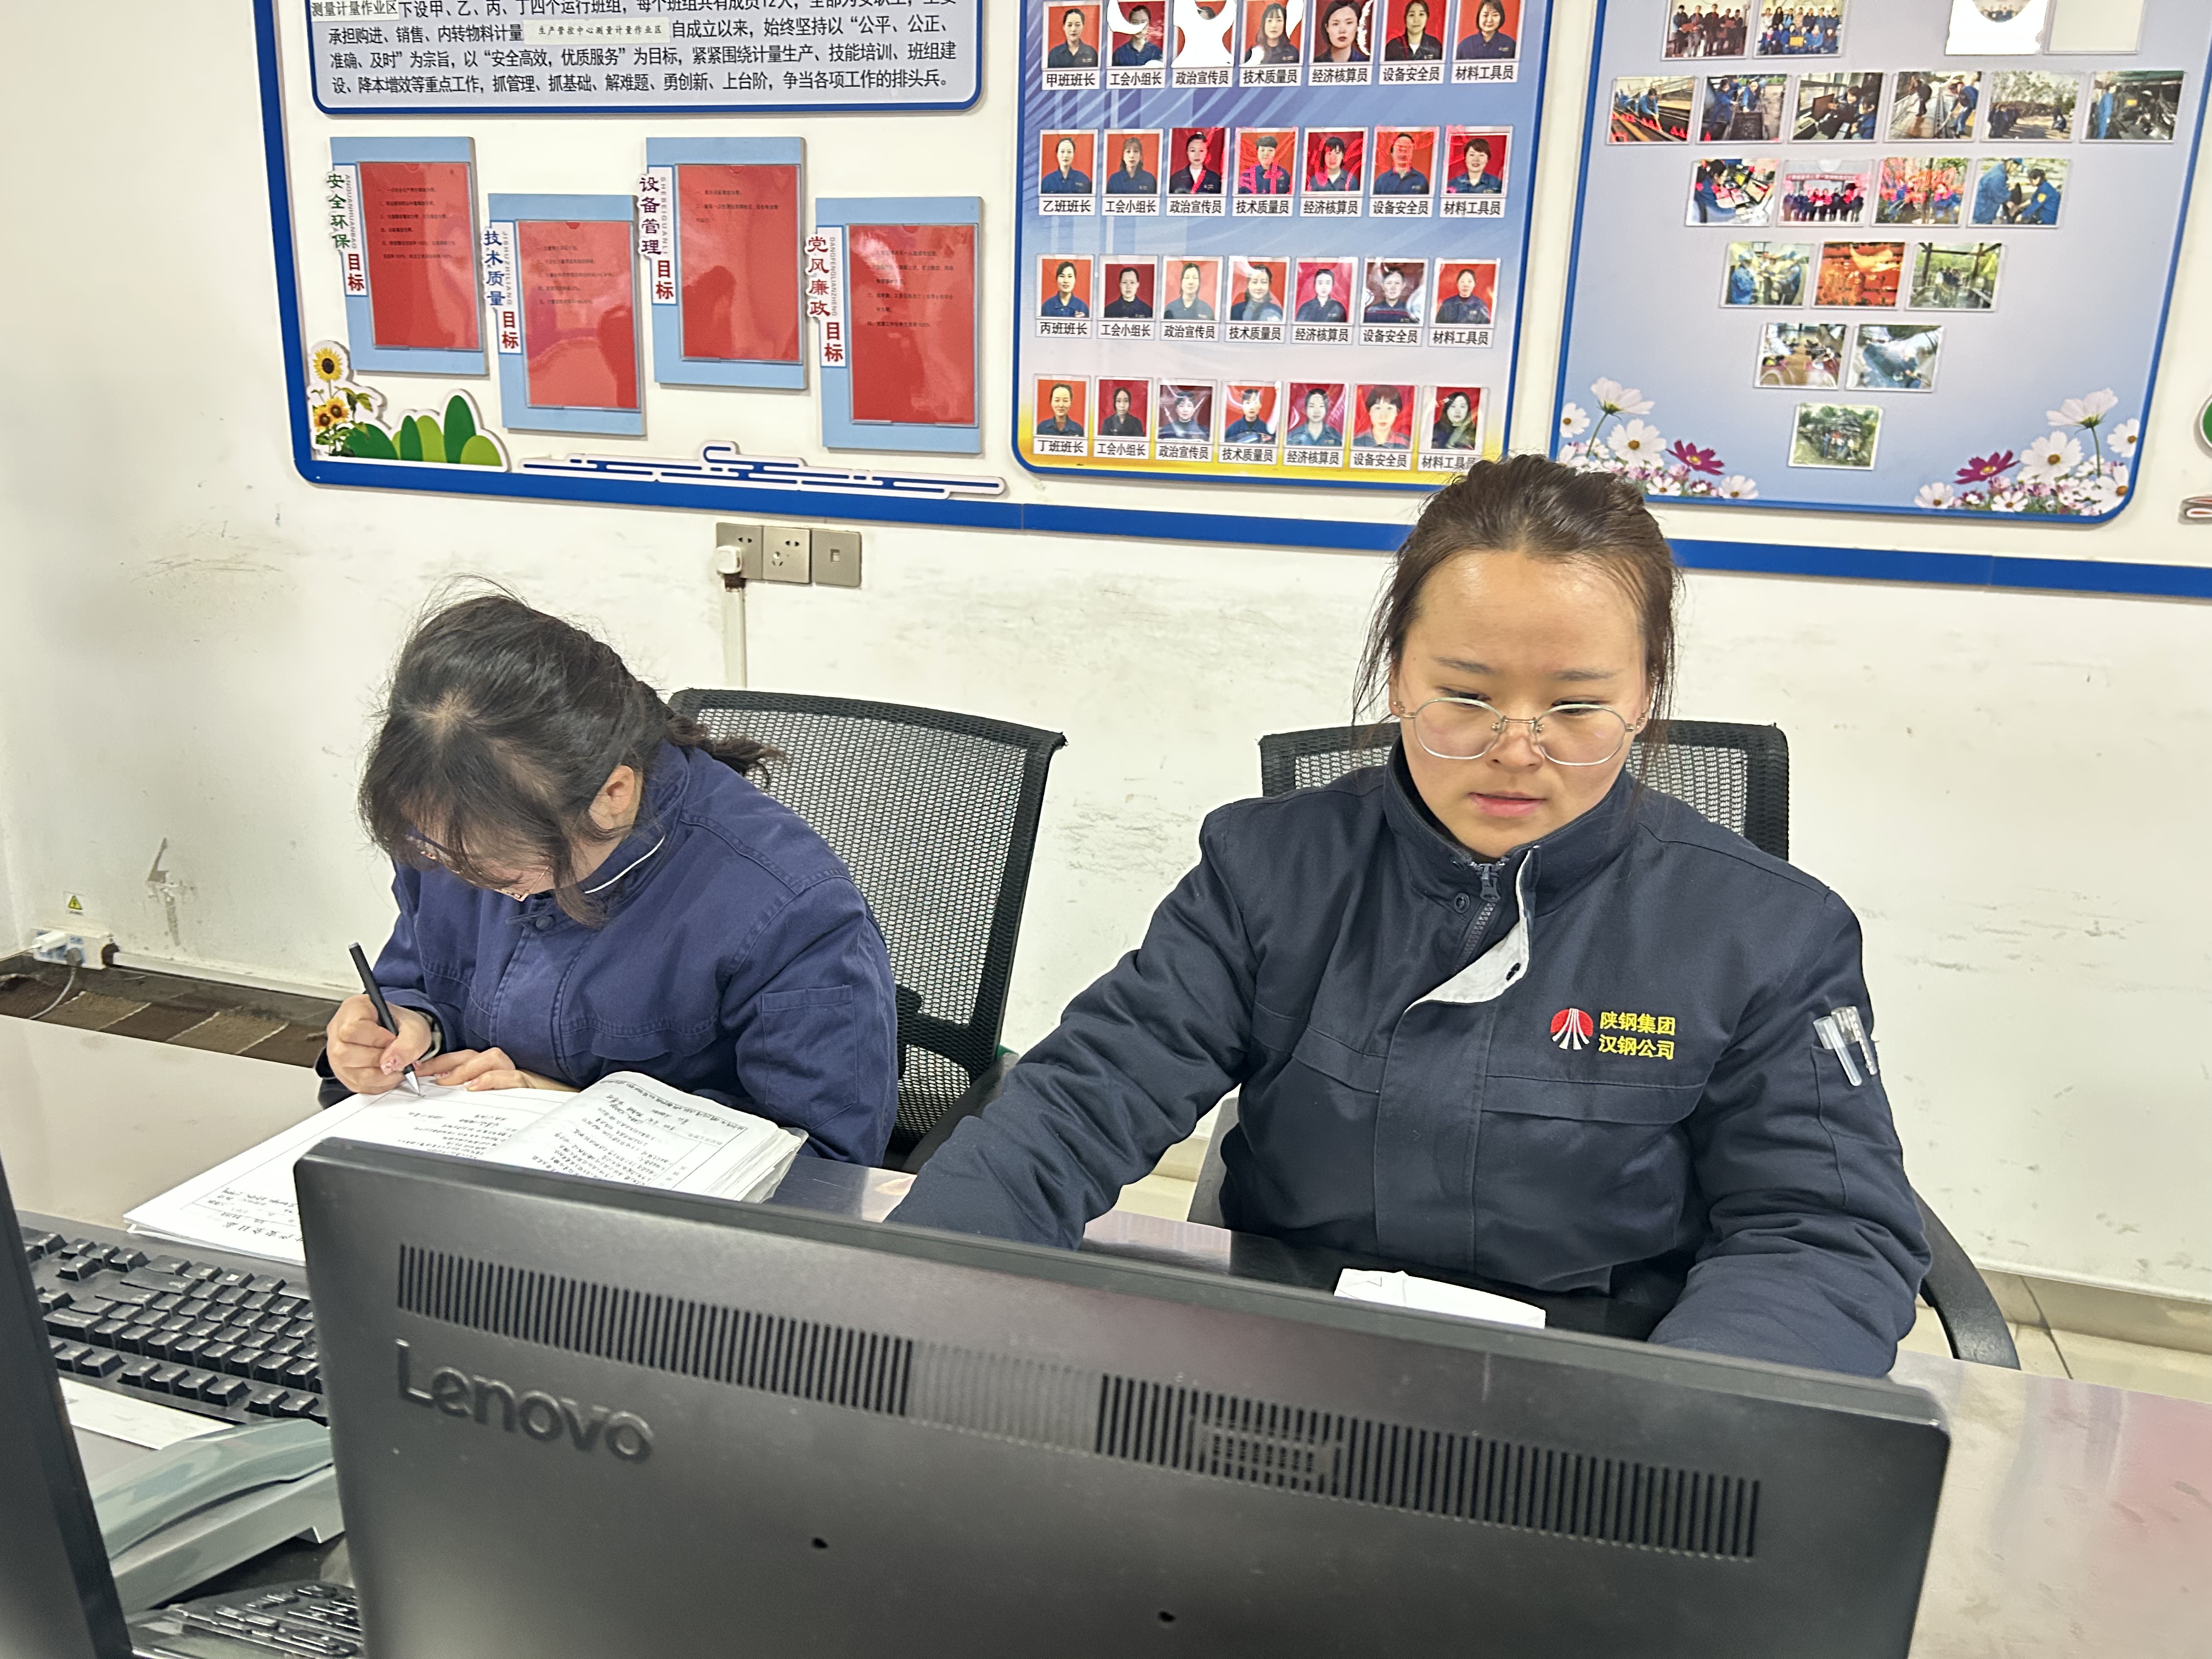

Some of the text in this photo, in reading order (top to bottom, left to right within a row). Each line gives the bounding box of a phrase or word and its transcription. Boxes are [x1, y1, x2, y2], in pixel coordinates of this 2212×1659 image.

[1110, 72, 1162, 86] 工会小组长
[1176, 70, 1228, 84] 政治宣传员
[1243, 69, 1297, 84] 技术质量员
[1312, 67, 1367, 83] 经济核算员
[1383, 66, 1439, 81] 设备安全员
[1456, 65, 1513, 80] 材料工具员
[1047, 73, 1095, 87] 甲班班长
[327, 173, 350, 249] 安全环保
[1043, 200, 1091, 212] 乙班班长
[1105, 200, 1156, 213] 工会小组长
[1170, 200, 1221, 213] 政治宣传员
[1236, 200, 1289, 214] 技术质量员
[1304, 200, 1357, 215] 经济核算员
[1373, 200, 1428, 215] 设备安全员
[1444, 201, 1500, 215] 材料工具员
[639, 177, 662, 255] 设备管理
[348, 253, 364, 291] 目标
[483, 230, 505, 306] 技术质量
[656, 260, 674, 299] 目标
[807, 236, 830, 317] 党风廉政
[502, 312, 519, 349] 目标
[1040, 321, 1087, 335] 丙班班长
[1101, 323, 1150, 337] 工会小组长
[1164, 325, 1215, 338] 政治宣传员
[1229, 326, 1280, 340] 技术质量员
[1295, 328, 1348, 342] 经济核算员
[825, 322, 843, 362] 目标
[1363, 329, 1417, 343] 设备安全员
[1434, 331, 1488, 345] 材料工具员
[1038, 440, 1084, 453] 丁班班长
[1098, 443, 1146, 456] 工会小组长
[1159, 445, 1208, 459] 政治宣传员
[1222, 449, 1272, 462] 技术质量员
[1288, 451, 1339, 465] 经济核算员
[1355, 453, 1406, 467] 设备安全员
[1600, 1011, 1675, 1036] 陕钢集团
[1598, 1034, 1674, 1060] 汉钢公司
[395, 1339, 654, 1464] Lenovo
